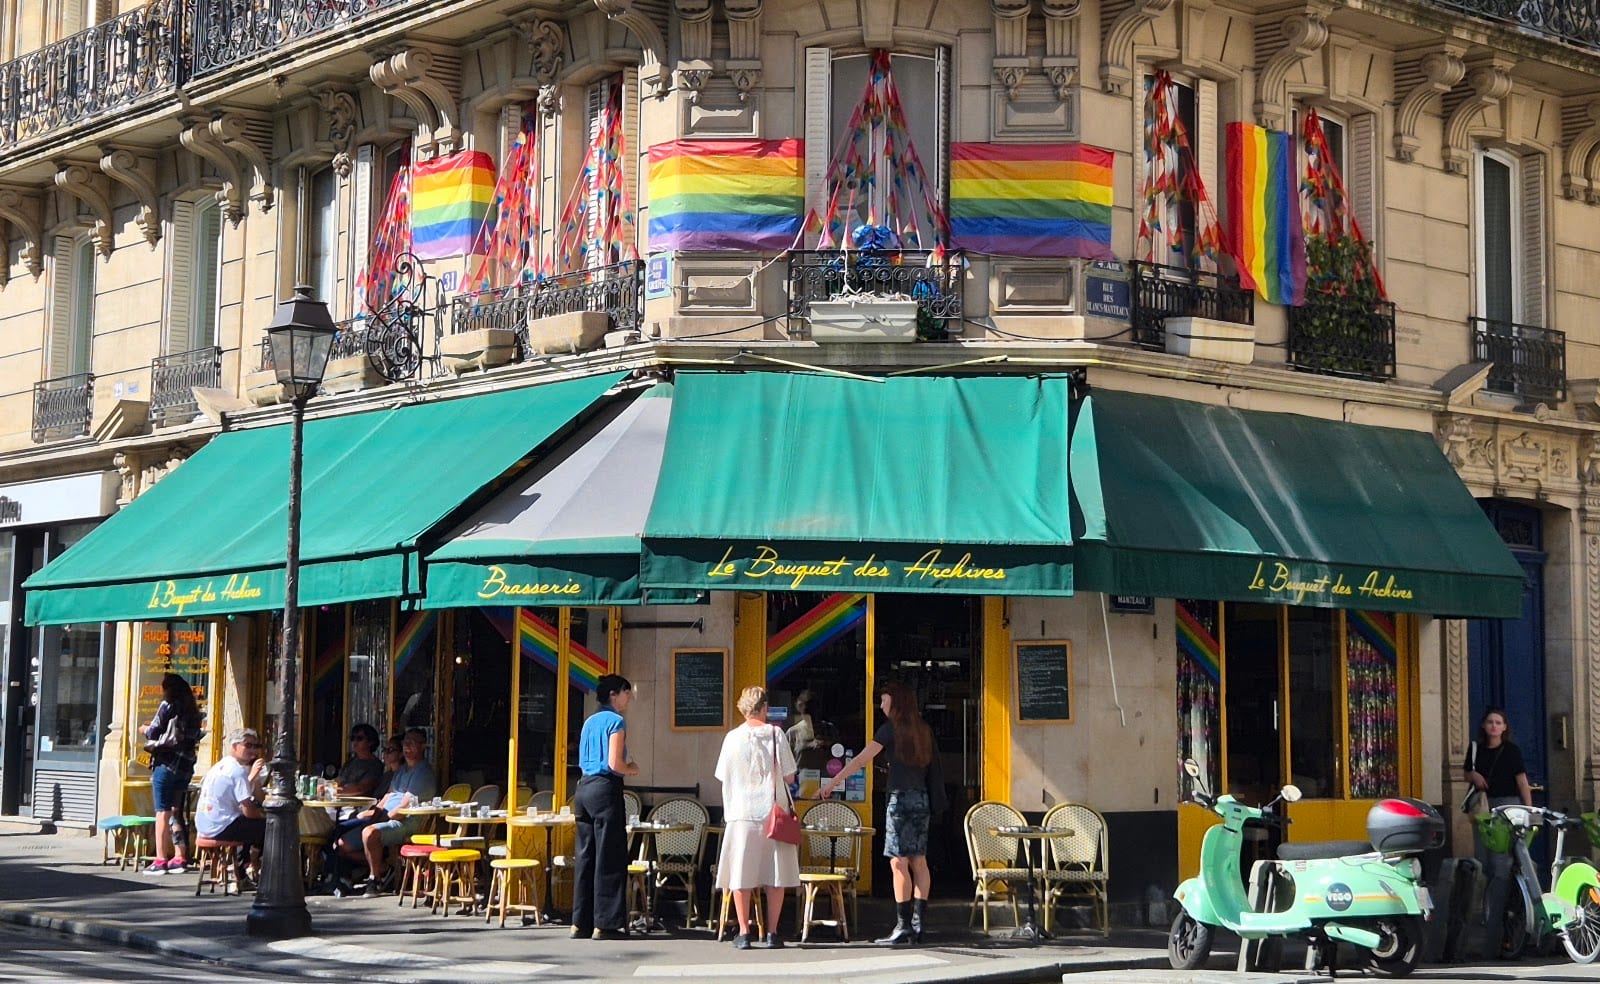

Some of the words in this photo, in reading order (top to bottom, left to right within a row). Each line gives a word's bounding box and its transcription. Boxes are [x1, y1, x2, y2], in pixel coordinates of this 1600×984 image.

[444, 272, 456, 290] 31
[1102, 282, 1113, 293] RUE
[1102, 294, 1114, 303] DES
[477, 565, 582, 599] Brasserie
[708, 546, 736, 577] Le
[744, 545, 853, 589] Bouquet
[853, 554, 889, 577] des
[904, 549, 1006, 580] Archives
[1248, 561, 1265, 590] Le
[1269, 562, 1331, 604] Bouquet
[1332, 574, 1352, 595] des
[1358, 570, 1413, 599] Archives
[147, 581, 159, 609] Le
[160, 580, 202, 616] Bouquet
[202, 581, 216, 602] des
[221, 574, 261, 601] Archives
